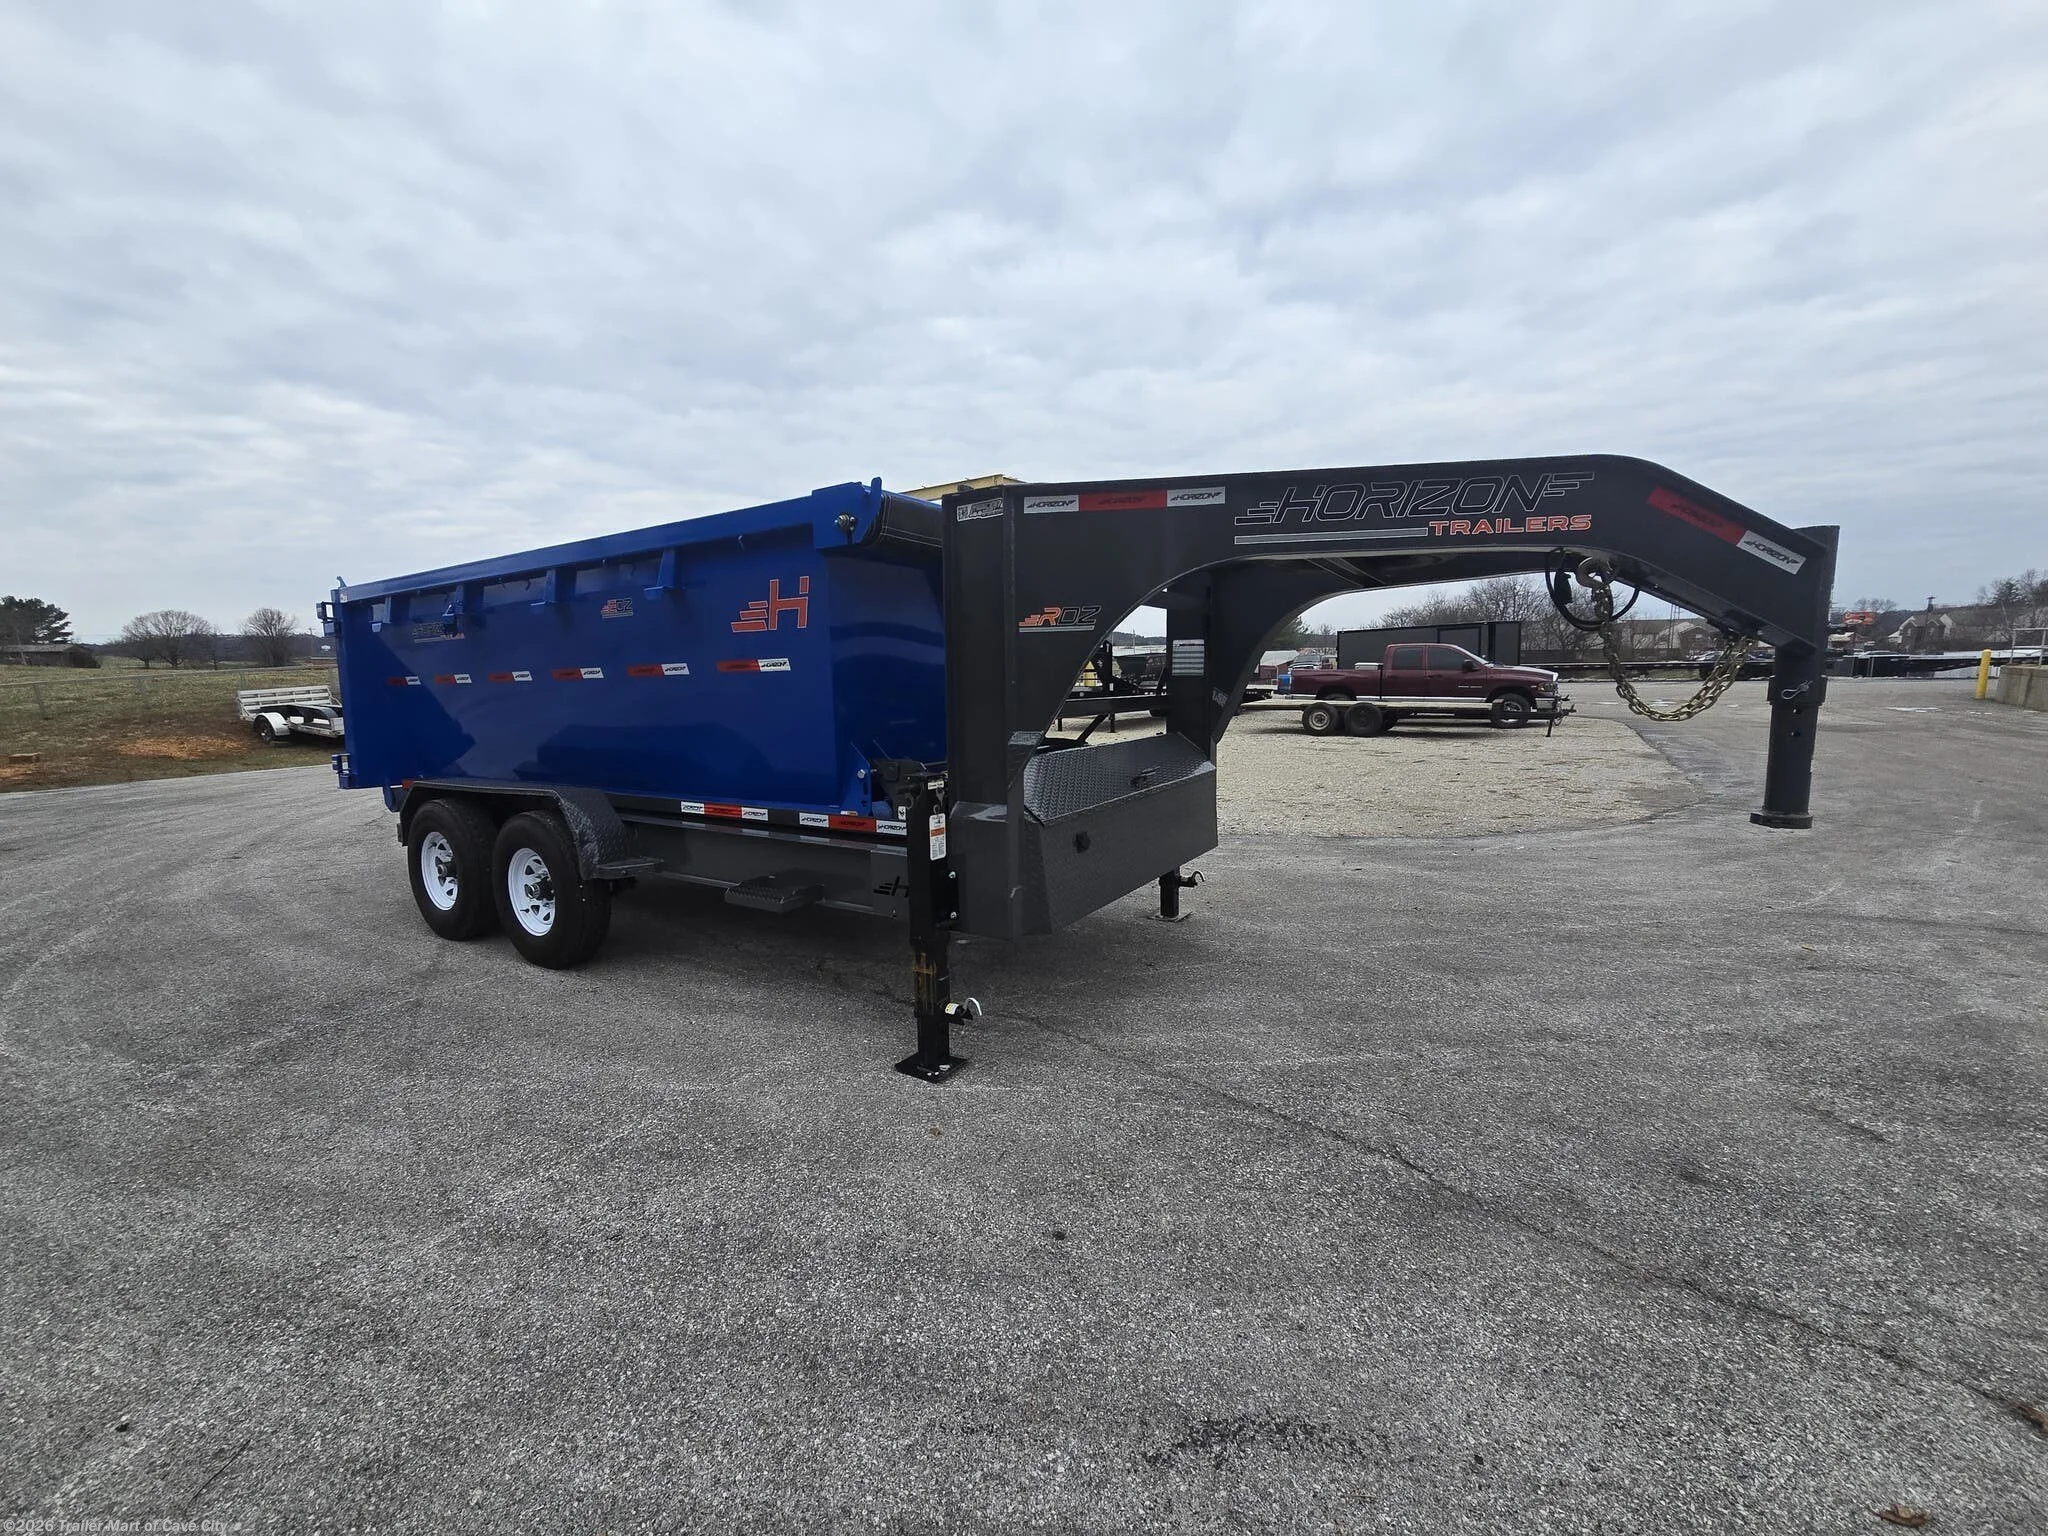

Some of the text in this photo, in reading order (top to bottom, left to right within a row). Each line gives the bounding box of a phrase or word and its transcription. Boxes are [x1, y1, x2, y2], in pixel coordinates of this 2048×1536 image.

[1027, 499, 1077, 510] HORIZON
[1170, 490, 1222, 502] HORIZON
[1255, 472, 1575, 524] HORIZON
[1428, 514, 1592, 536] TRAILERS
[1744, 540, 1800, 565] HORIZON
